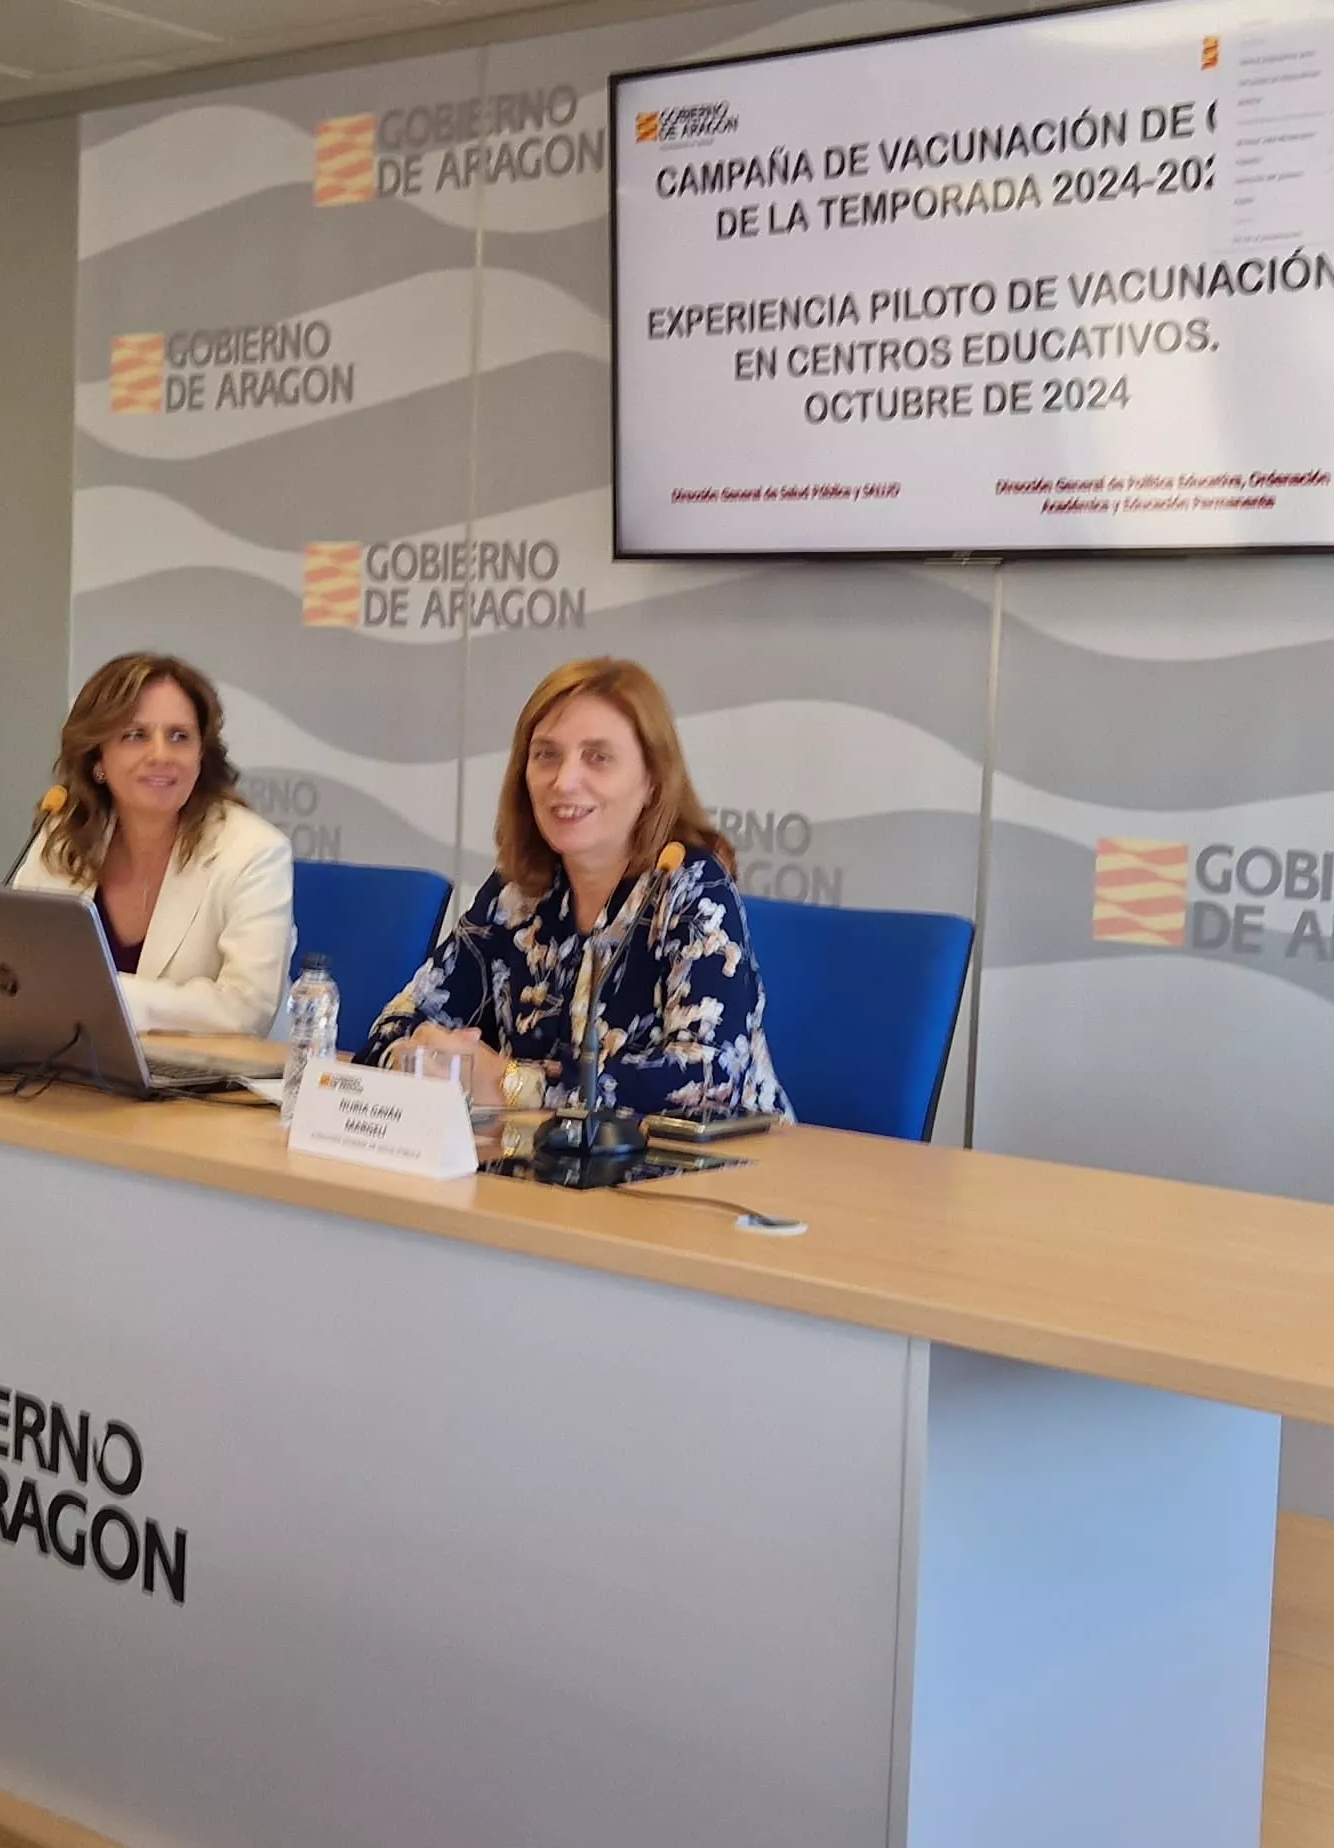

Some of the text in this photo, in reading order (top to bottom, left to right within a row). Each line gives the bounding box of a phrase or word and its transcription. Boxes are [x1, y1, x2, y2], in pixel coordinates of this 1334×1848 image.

[378, 84, 578, 150] GOBIERNO
[377, 127, 606, 195] DE ARAGON
[656, 145, 814, 200] CAMPAÑA
[824, 141, 870, 181] DE
[878, 105, 1129, 174] VACUNACIÓN
[1140, 100, 1196, 144] DE
[717, 202, 761, 241] DE
[768, 197, 810, 236] LA
[816, 173, 1042, 231] TEMPORADA
[648, 290, 862, 340] EXPERIENCIA
[870, 280, 998, 324] PILOTO
[1007, 274, 1059, 314] DE
[166, 320, 330, 369] GOBIERNO
[734, 316, 1220, 381] EN CENTROS EDUCATIVOS.
[166, 362, 354, 413] DE ARAGON
[804, 374, 1133, 425] OCTUBRE DE 2024
[367, 539, 560, 582] GOBIERNO
[364, 586, 586, 630] DE ARAGON
[1191, 900, 1266, 954] DE
